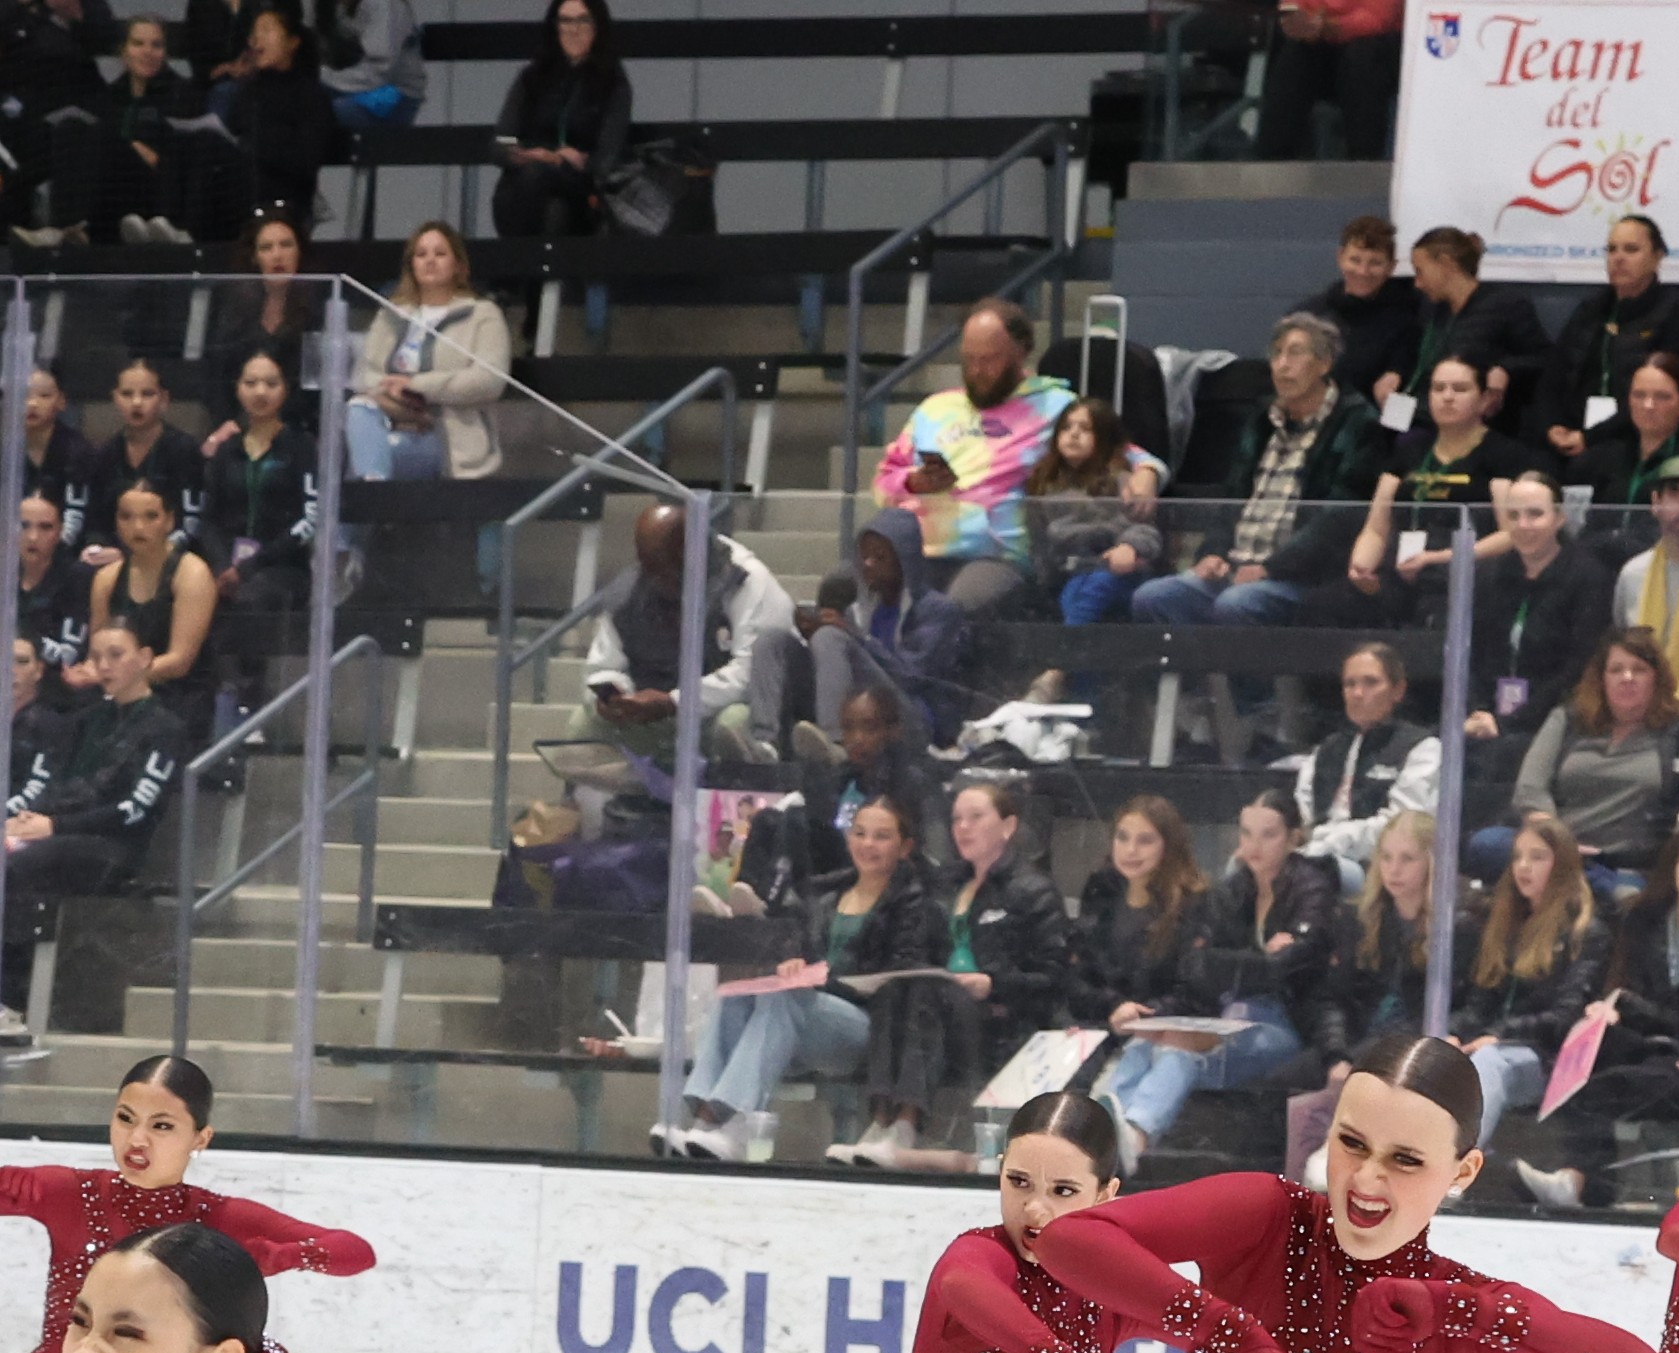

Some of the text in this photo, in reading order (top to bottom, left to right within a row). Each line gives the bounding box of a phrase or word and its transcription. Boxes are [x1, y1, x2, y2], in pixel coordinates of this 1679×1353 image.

[1477, 14, 1645, 87] Team
[1545, 86, 1611, 129] del
[1494, 137, 1673, 231] Sol
